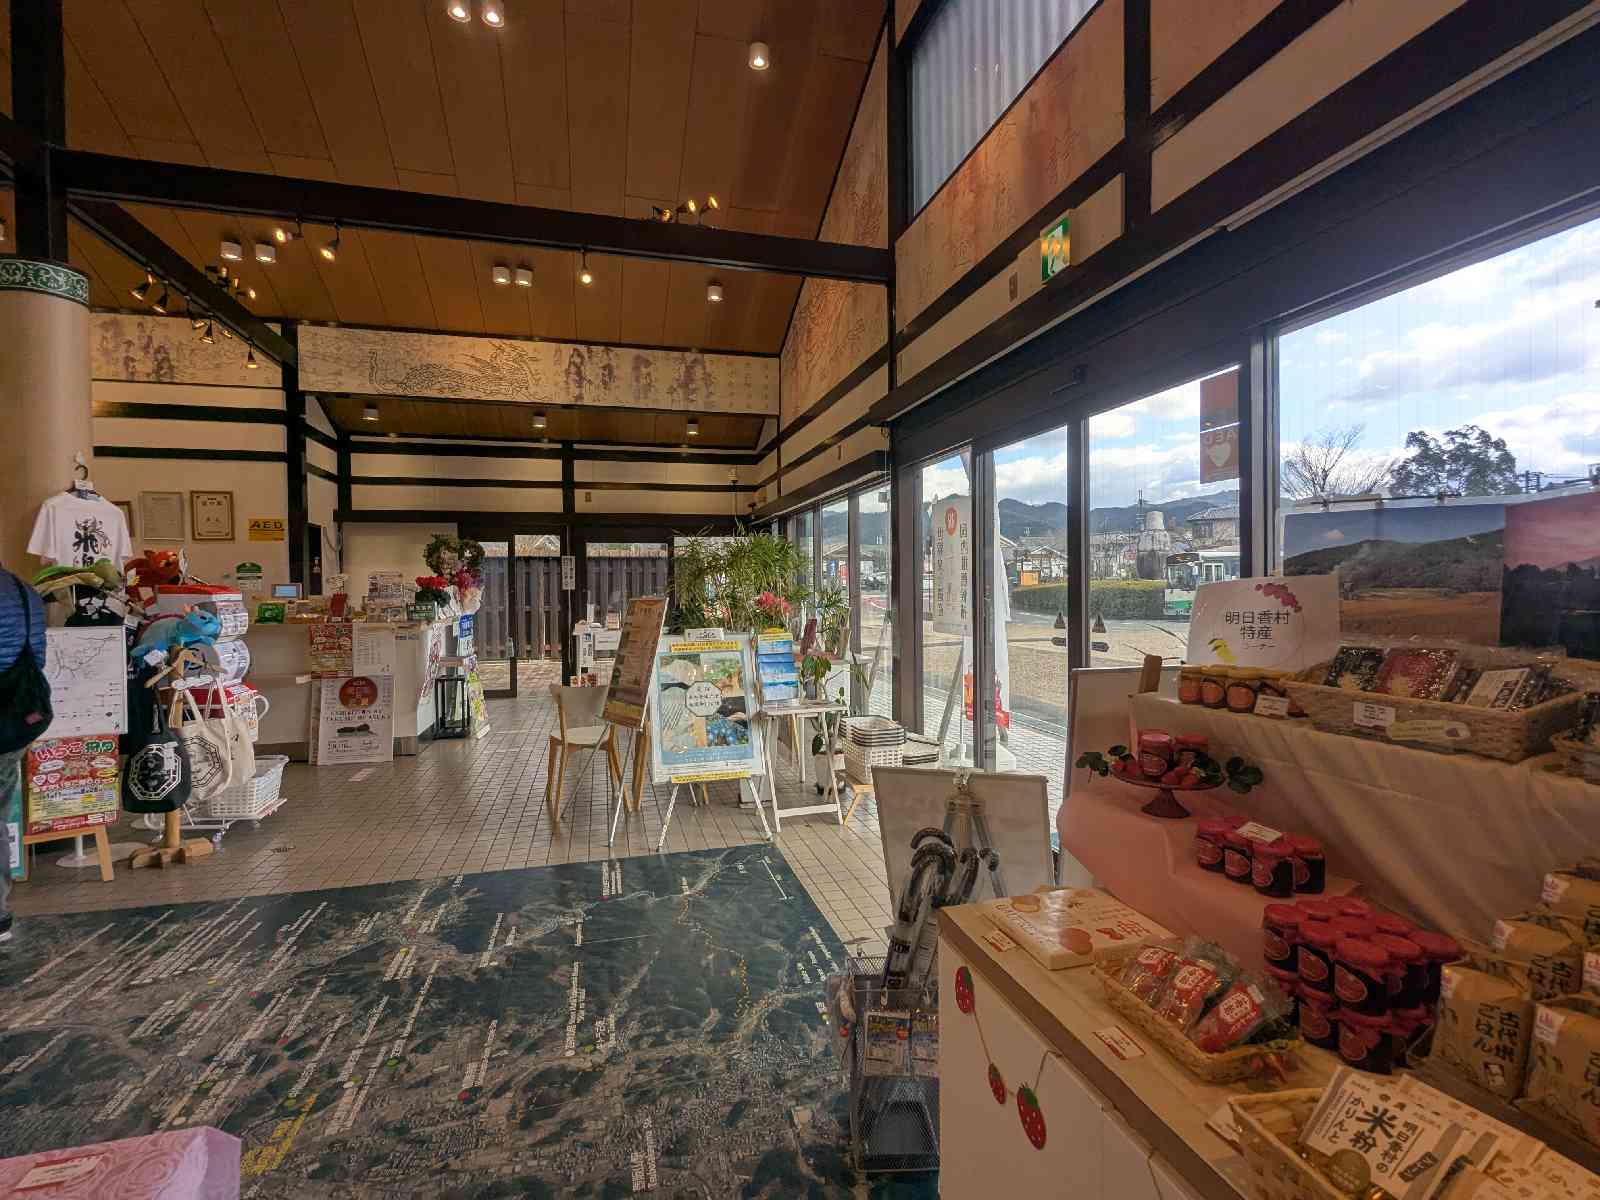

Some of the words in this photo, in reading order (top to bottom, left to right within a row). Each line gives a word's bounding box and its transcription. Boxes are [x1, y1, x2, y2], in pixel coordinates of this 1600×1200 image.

[249, 520, 283, 529] AED
[1225, 610, 1291, 625] 明日香村
[1240, 625, 1273, 640] 特産
[1473, 1002, 1502, 1053] ごはん
[1349, 1104, 1400, 1155] 米粉
